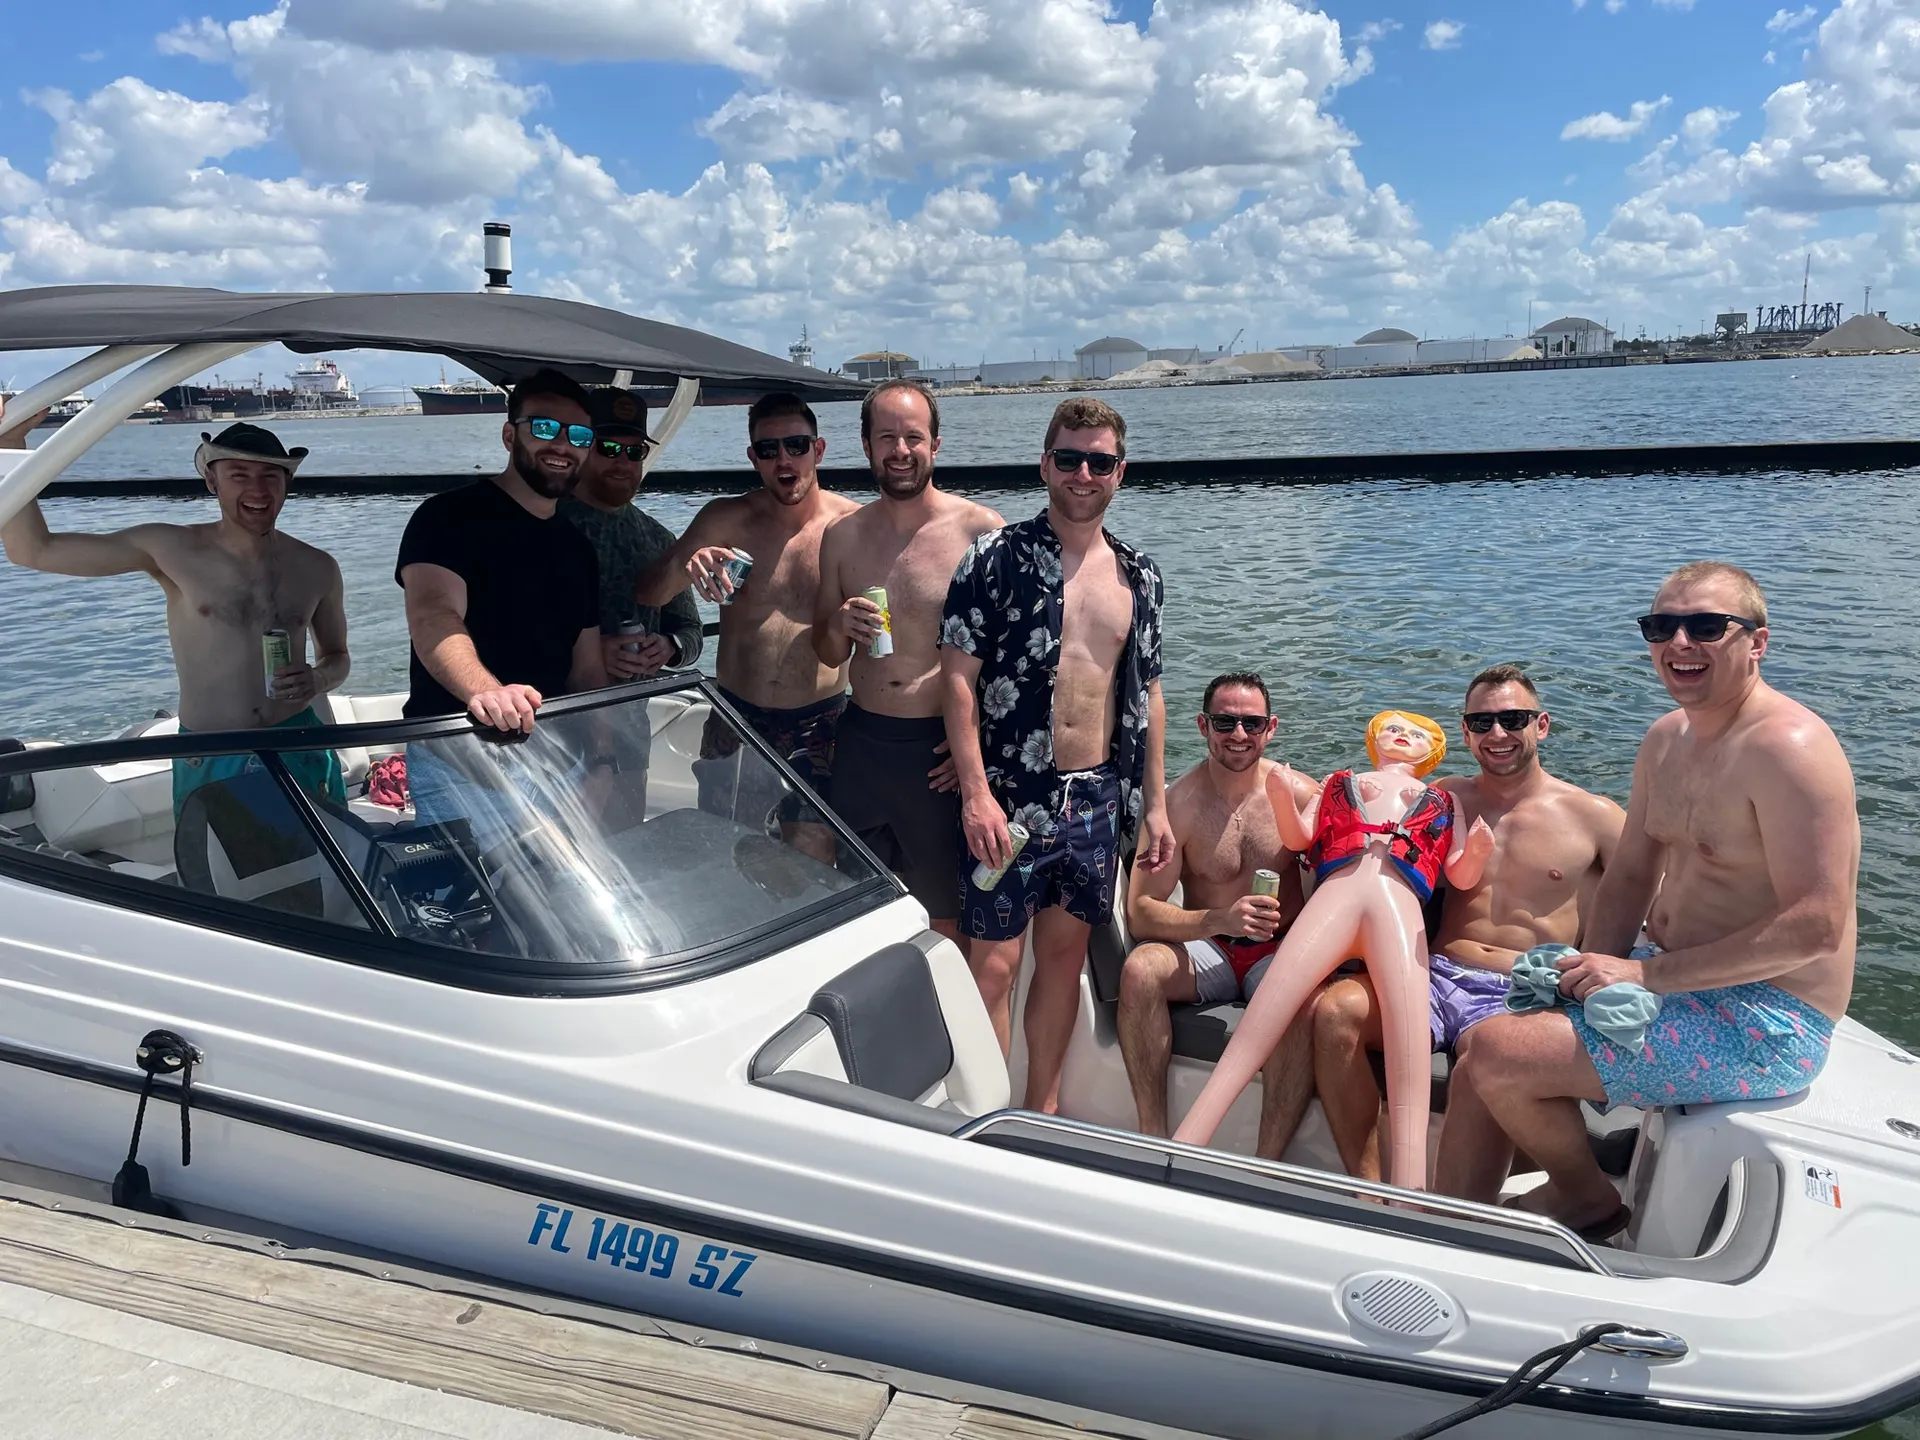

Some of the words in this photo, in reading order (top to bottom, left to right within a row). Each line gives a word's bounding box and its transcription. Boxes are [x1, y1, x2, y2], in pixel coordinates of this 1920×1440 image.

[527, 1203, 574, 1254] FL
[586, 1217, 680, 1279] 1499
[688, 1244, 759, 1298] SZ
